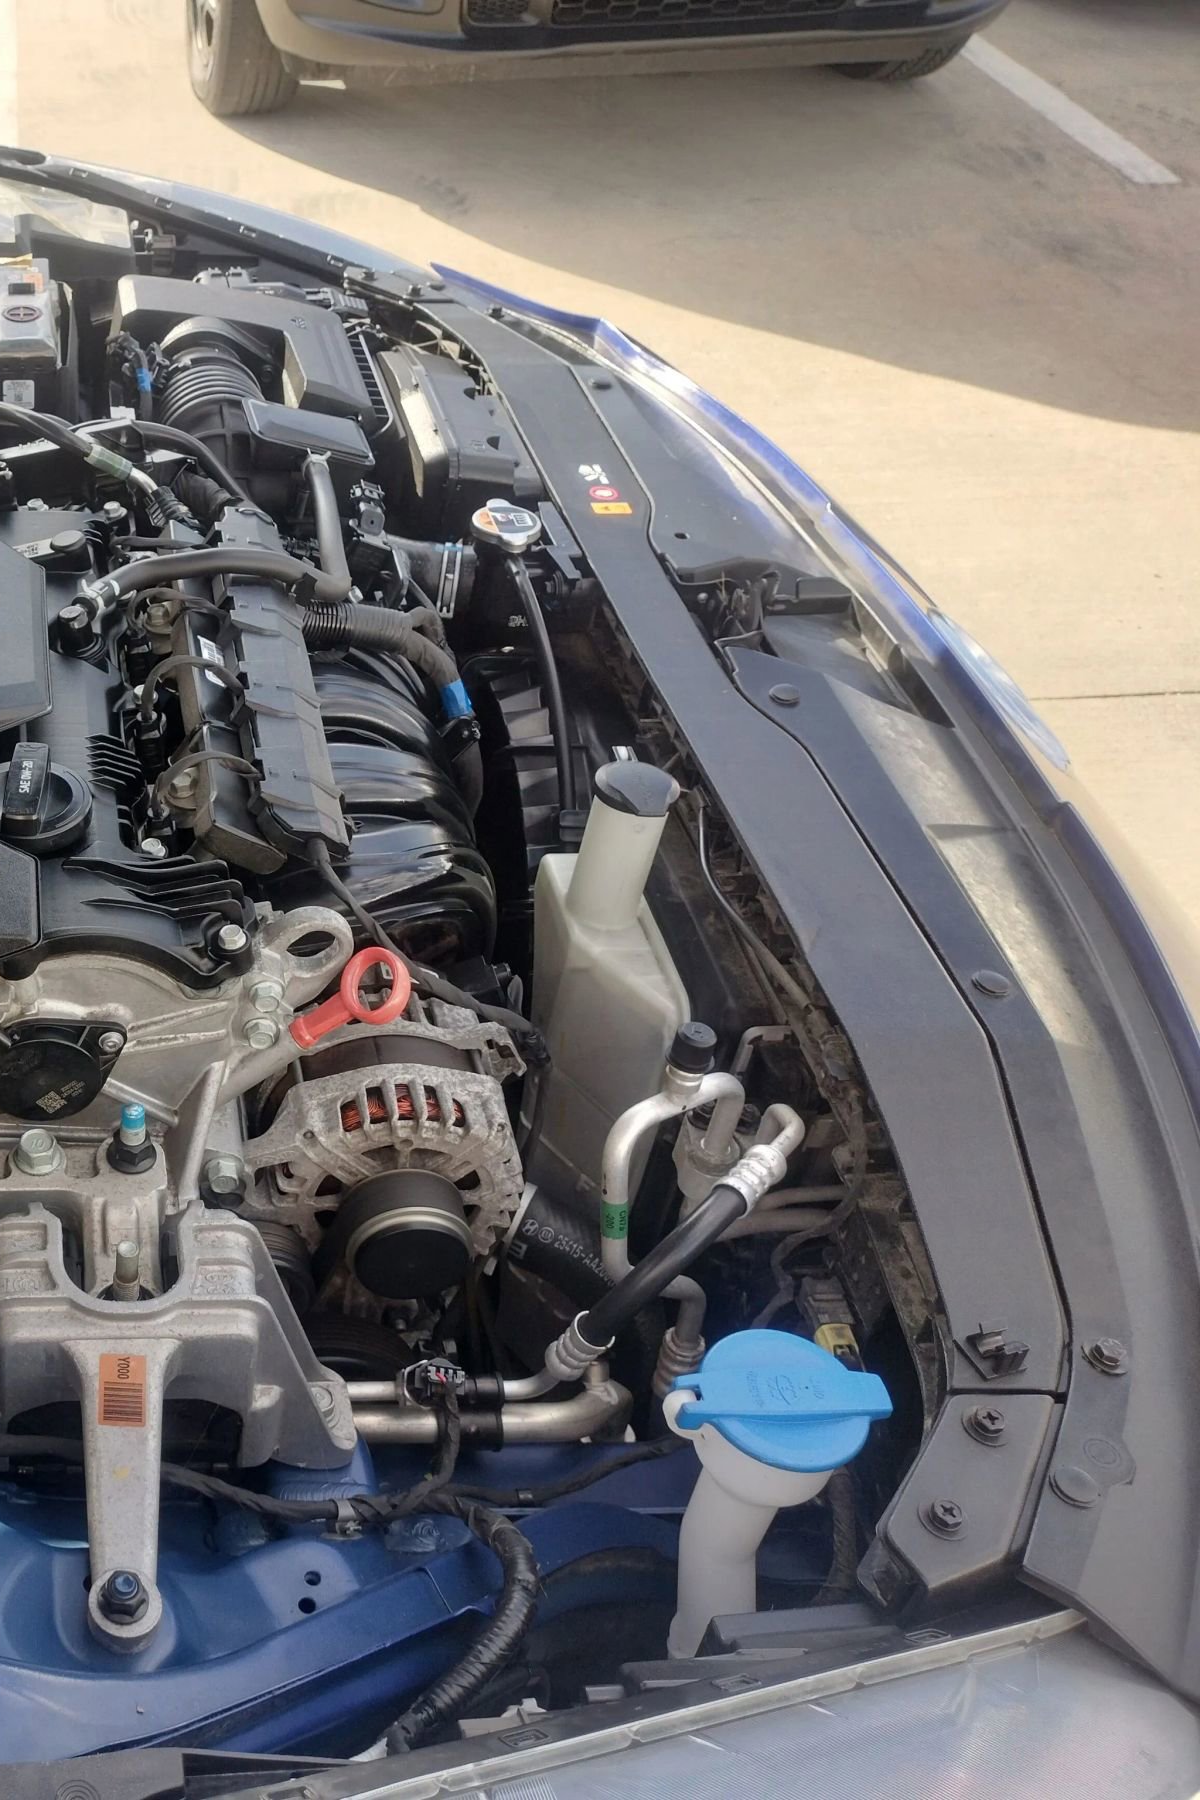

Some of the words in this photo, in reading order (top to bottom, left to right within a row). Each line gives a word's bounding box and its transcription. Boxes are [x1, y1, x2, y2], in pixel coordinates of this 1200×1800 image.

[20, 760, 34, 780] 0W-20
[18, 780, 31, 794] SAE
[117, 1356, 130, 1380] Y000
